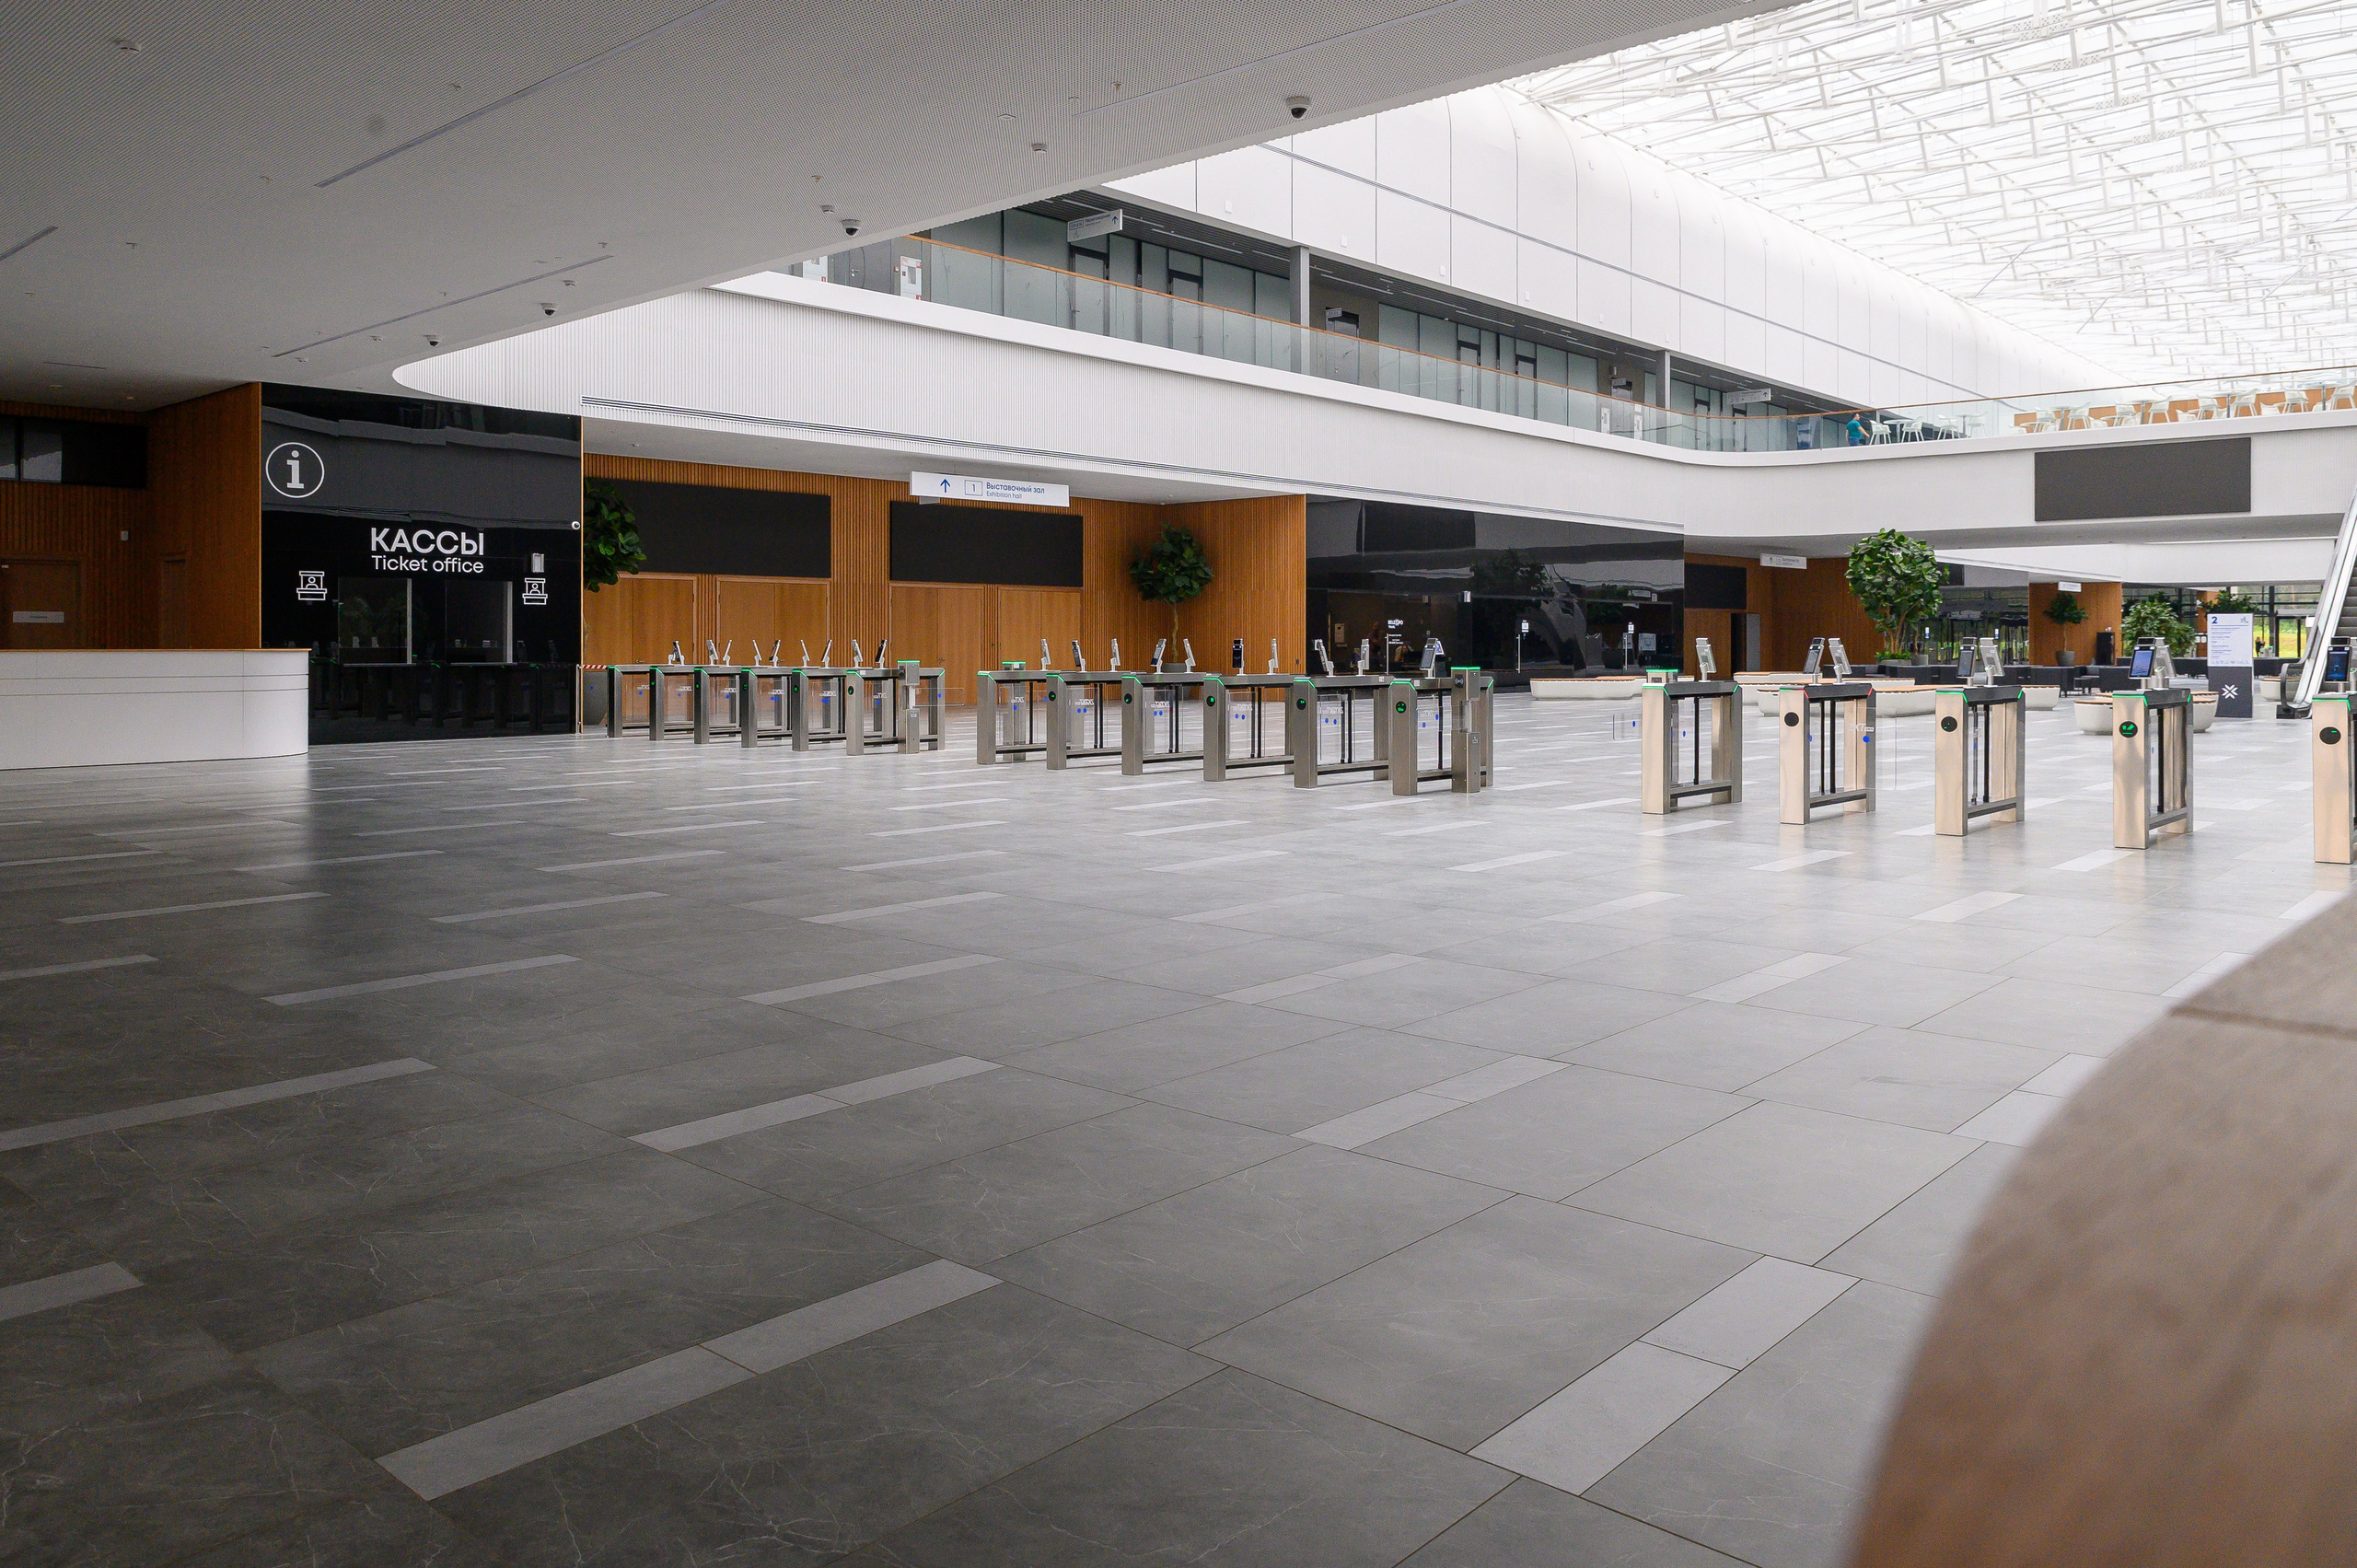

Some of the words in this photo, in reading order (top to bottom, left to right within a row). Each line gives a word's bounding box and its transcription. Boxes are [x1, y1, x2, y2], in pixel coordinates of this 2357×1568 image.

[986, 482, 1032, 493] Выставочный
[986, 490, 1012, 499] Exhibition
[371, 527, 484, 556] КАССЫ
[371, 554, 428, 572] Ticket
[433, 556, 484, 574] office
[2211, 616, 2218, 624] 2
